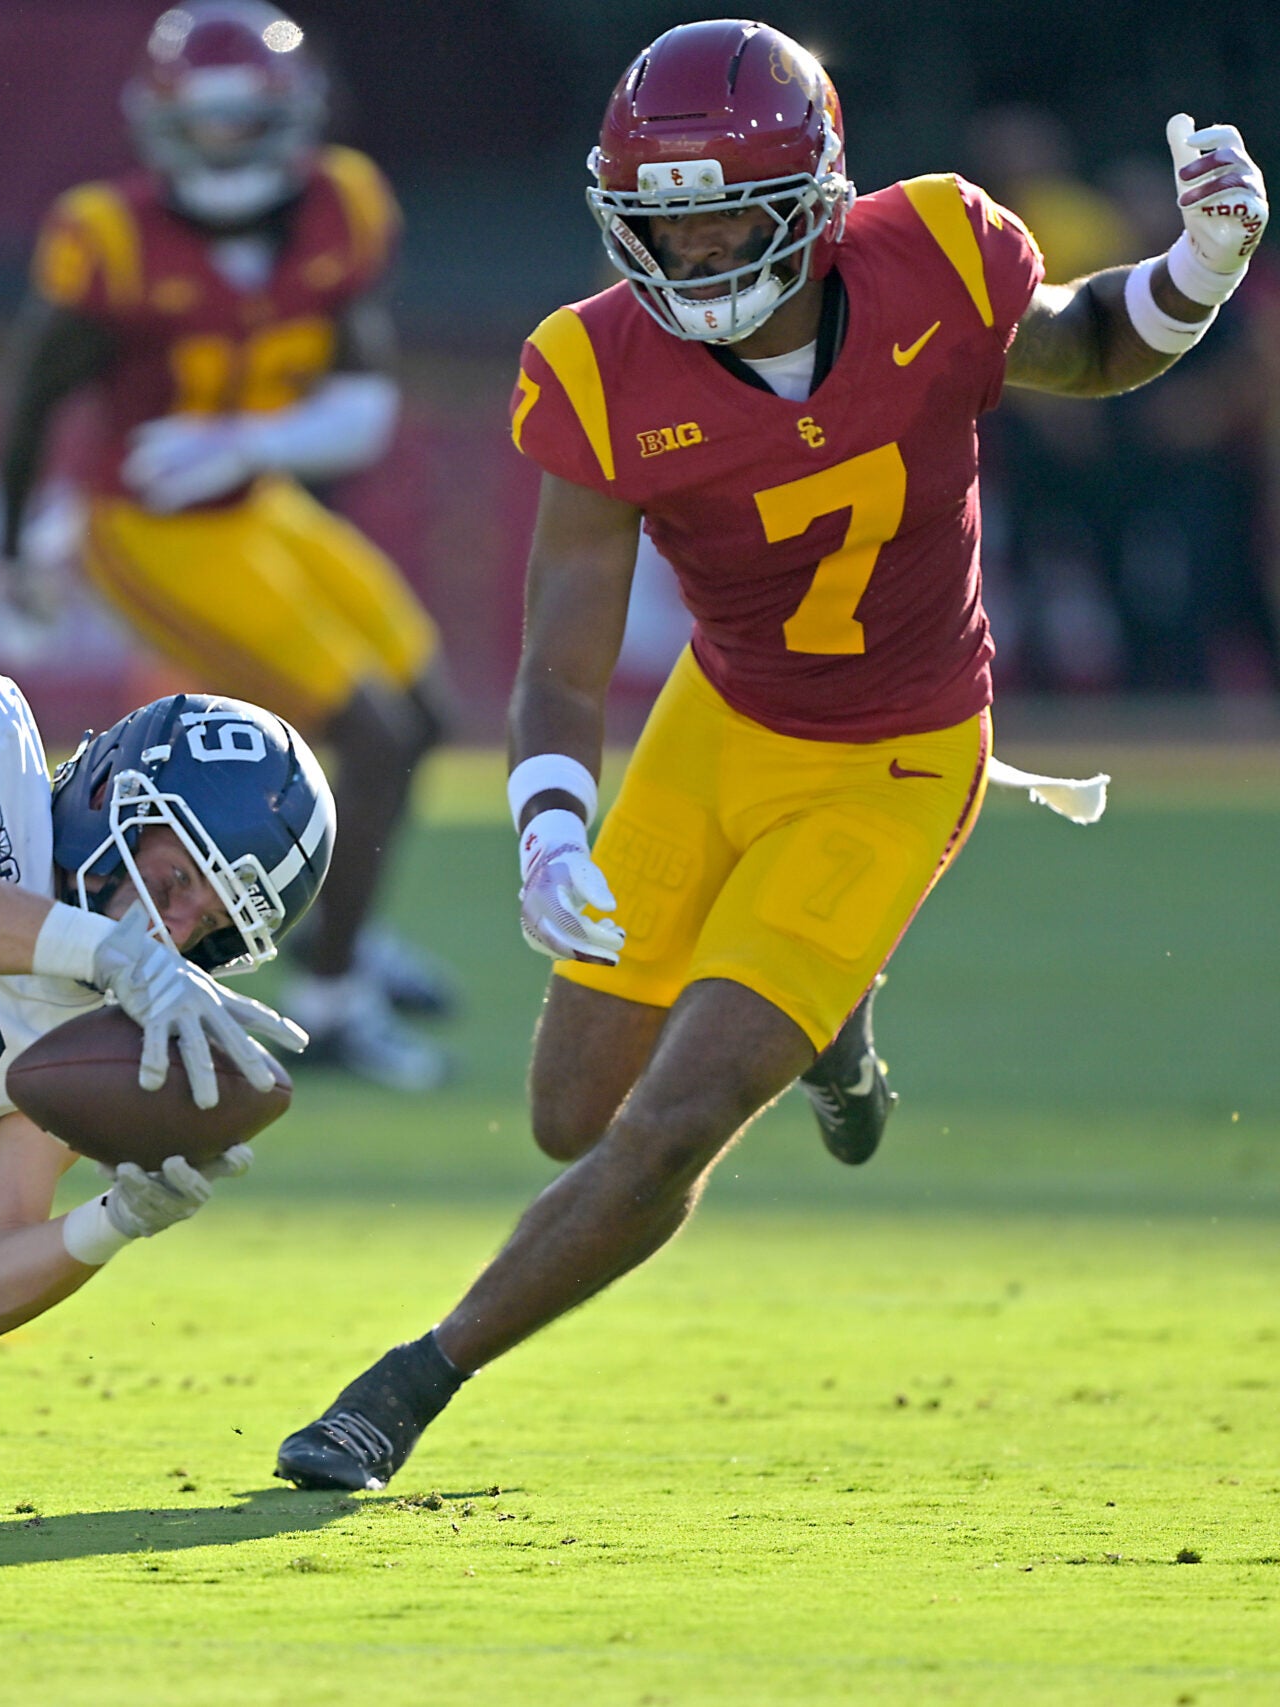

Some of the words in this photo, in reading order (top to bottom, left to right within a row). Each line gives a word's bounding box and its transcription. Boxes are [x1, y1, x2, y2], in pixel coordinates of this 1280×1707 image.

[614, 221, 658, 273] TROJANS
[753, 440, 908, 655] 7
[180, 711, 267, 763] 19
